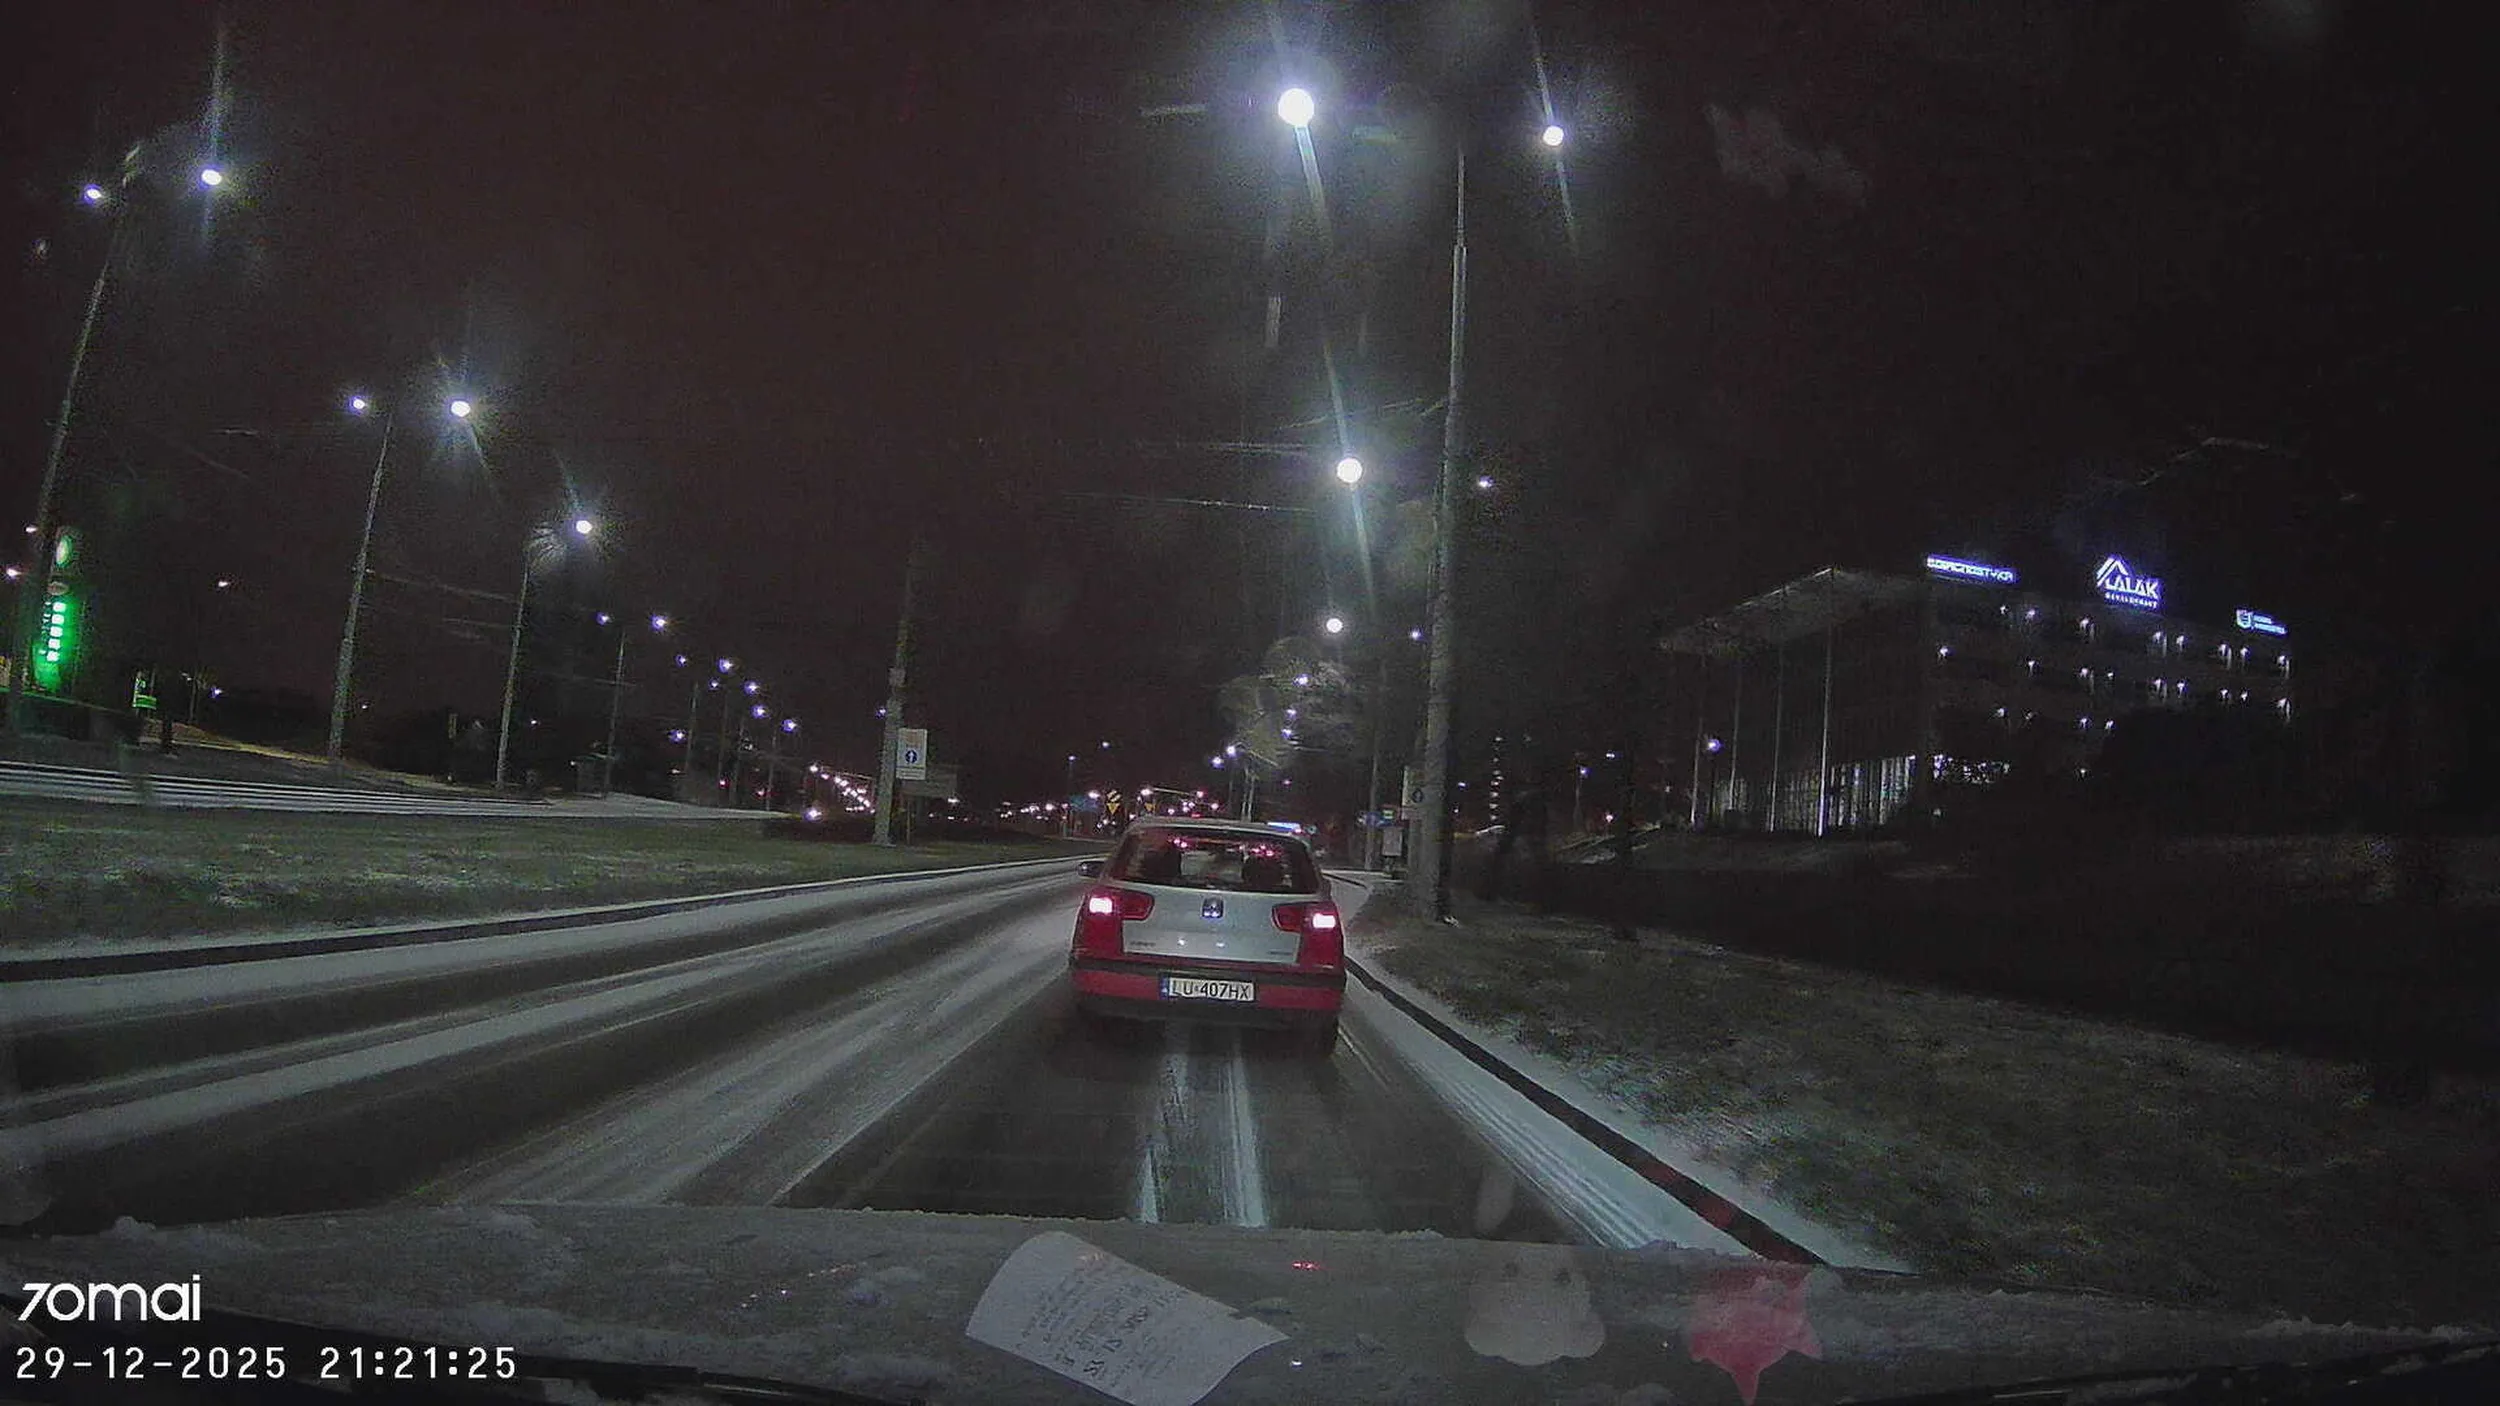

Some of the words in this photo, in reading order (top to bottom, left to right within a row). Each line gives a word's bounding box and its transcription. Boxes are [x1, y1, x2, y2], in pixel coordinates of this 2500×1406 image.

[2104, 575, 2159, 600] LALAK
[1172, 979, 1194, 997] LU
[1200, 981, 1250, 1000] 407HX
